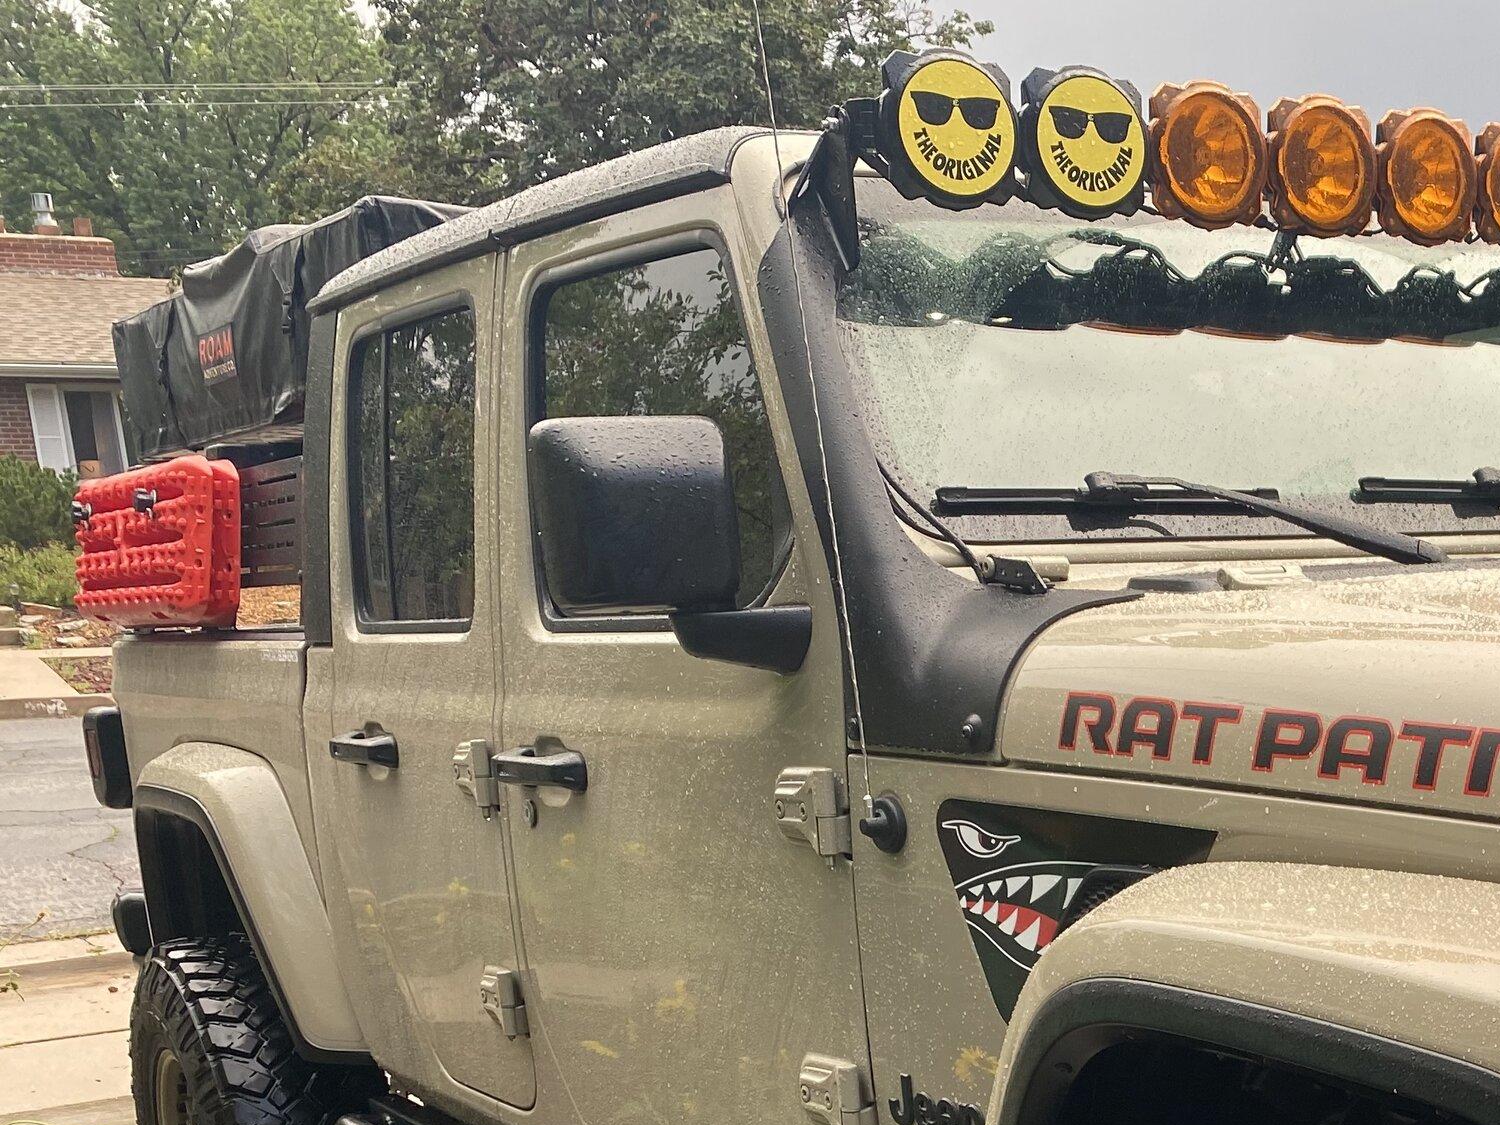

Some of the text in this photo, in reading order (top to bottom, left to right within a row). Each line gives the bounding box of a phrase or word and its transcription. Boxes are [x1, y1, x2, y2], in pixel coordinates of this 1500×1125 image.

[913, 127, 1001, 180] THE ORIGINAL
[1051, 141, 1133, 192] THE ORIGINAL
[199, 327, 233, 365] ROAM
[1059, 691, 1244, 766] RAT
